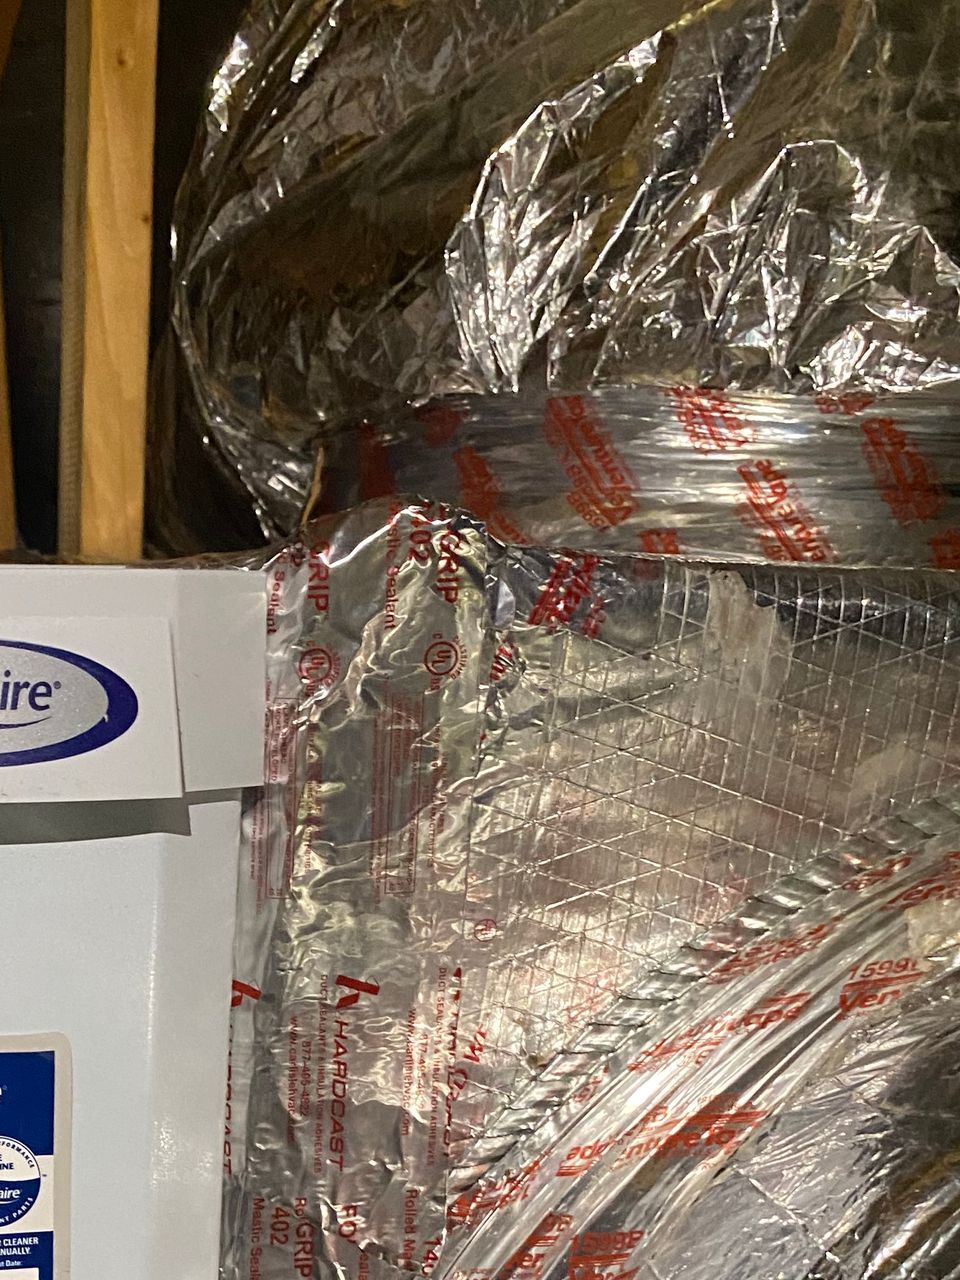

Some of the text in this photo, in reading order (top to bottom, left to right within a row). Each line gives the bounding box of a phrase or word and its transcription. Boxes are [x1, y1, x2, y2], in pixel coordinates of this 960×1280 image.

[266, 571, 284, 635] Sealant
[436, 968, 445, 993] DUCT
[328, 1020, 348, 1171] HARDCAST
[13, 1197, 33, 1218] PARTS
[250, 1198, 264, 1243] Mastic
[269, 1206, 289, 1245] 402
[403, 1190, 417, 1234] Rolled
[3, 1237, 39, 1246] CLEANER
[6, 1260, 23, 1268] Date:
